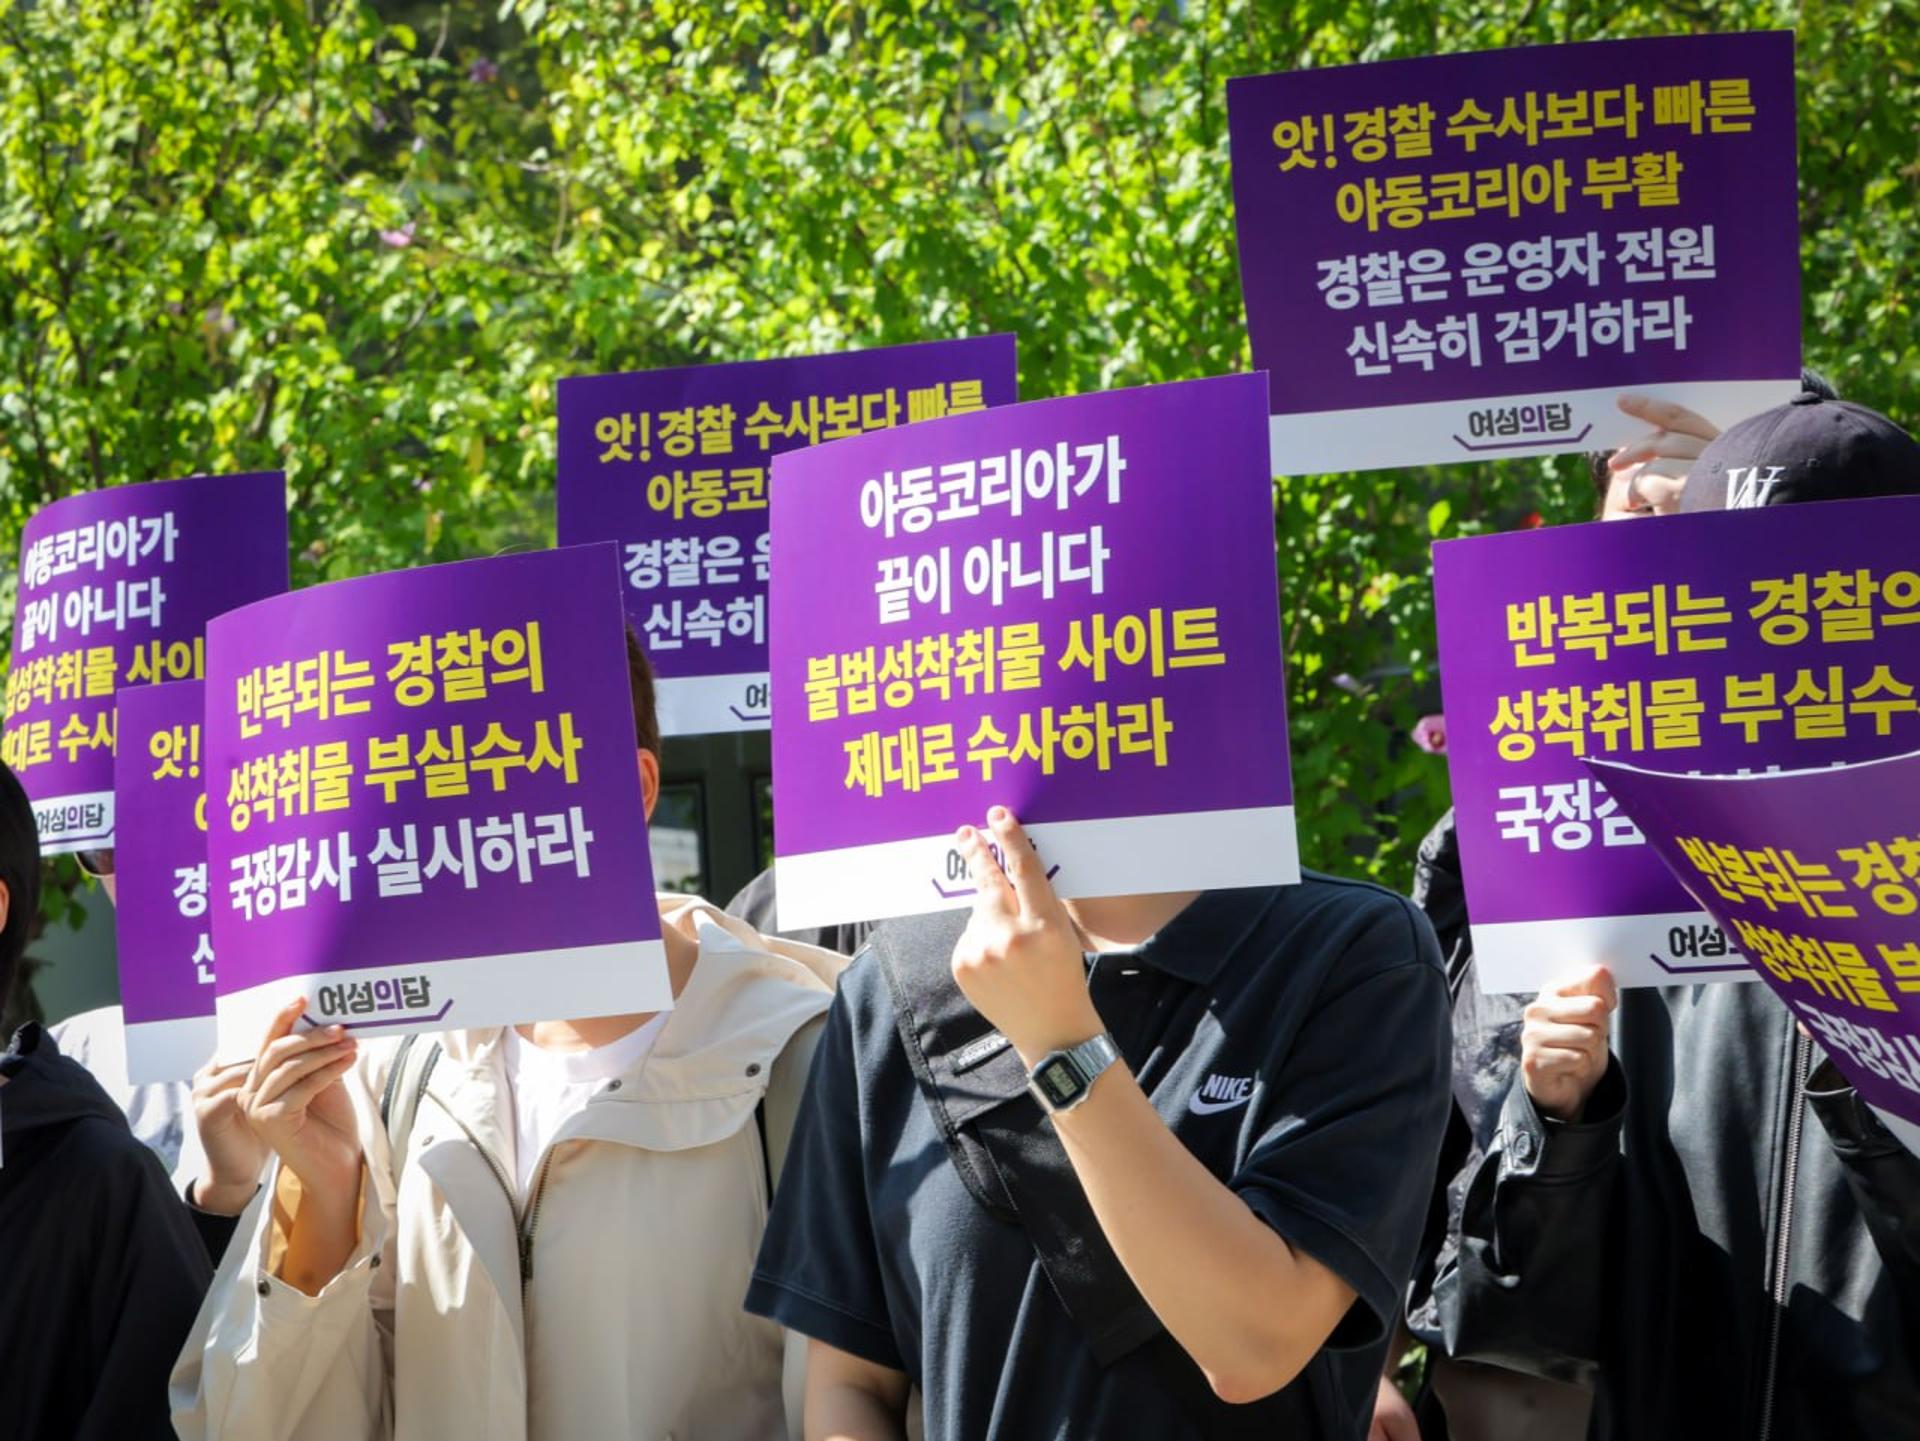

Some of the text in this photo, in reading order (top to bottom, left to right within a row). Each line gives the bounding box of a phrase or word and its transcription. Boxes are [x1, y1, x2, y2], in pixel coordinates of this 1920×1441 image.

[1273, 78, 1757, 173] 앗! 경찰 수사보다 빠른
[1336, 151, 1684, 232] 야동코리아 부활
[1316, 226, 1717, 310] 경찰은 운영자 전원
[1346, 296, 1694, 377] 신속히 검거하라
[595, 412, 651, 463] 앗!
[657, 403, 736, 457] 경찰
[744, 388, 901, 450] 수사보다
[1468, 402, 1573, 438] 여성의당
[647, 466, 771, 519] 야동코
[860, 434, 1127, 538] 야동코리아가
[24, 511, 180, 590] 야동코리아가
[624, 535, 744, 590] 경찰은
[873, 526, 1111, 624] 끝이 아니다
[20, 576, 167, 653] 끝이 아니다
[643, 594, 765, 651] 신속히
[1506, 583, 1733, 668] 반복되는
[236, 622, 545, 740] 반복되는 경찰의
[804, 607, 1227, 722] 불법성착취물 사이트
[843, 696, 1174, 799] 제대로 수사하라
[1488, 665, 1920, 762] 성착취물 부실수
[227, 741, 353, 832] 성착취물
[365, 713, 582, 804] 부실수사
[36, 803, 105, 835] 여성의당
[229, 830, 357, 921] 국정감사
[368, 806, 594, 897] 실시하라
[1676, 836, 1859, 918] 반복되는
[1669, 925, 1742, 957] 여성
[1731, 918, 1900, 1013] 성착취물
[318, 975, 431, 1016] 여성의당
[1202, 1074, 1253, 1101] NIKE
